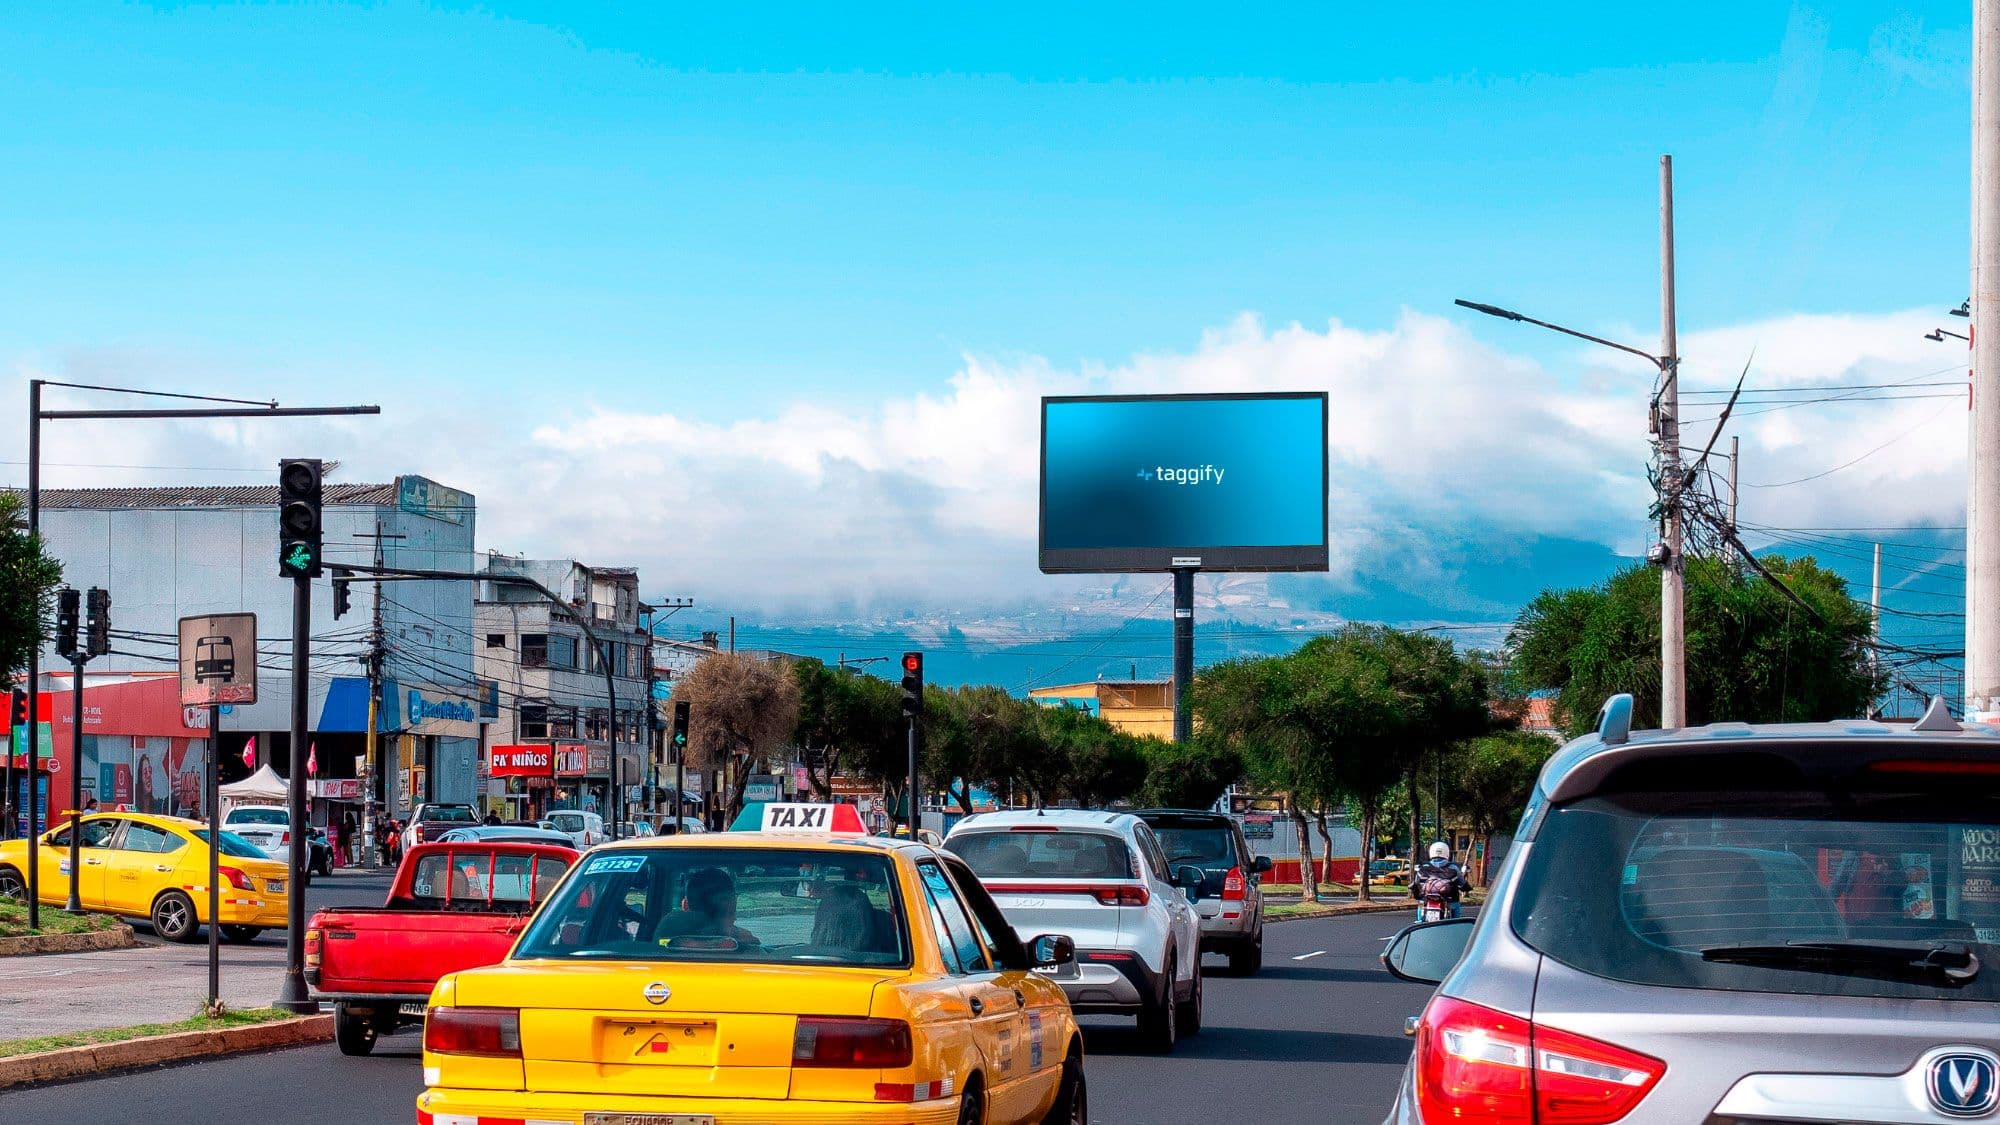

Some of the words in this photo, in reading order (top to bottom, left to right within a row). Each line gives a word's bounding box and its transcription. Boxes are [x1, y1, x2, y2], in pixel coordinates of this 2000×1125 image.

[1156, 465, 1225, 485] taggify
[512, 751, 548, 767] NIÑOS
[771, 807, 826, 828] TAXI
